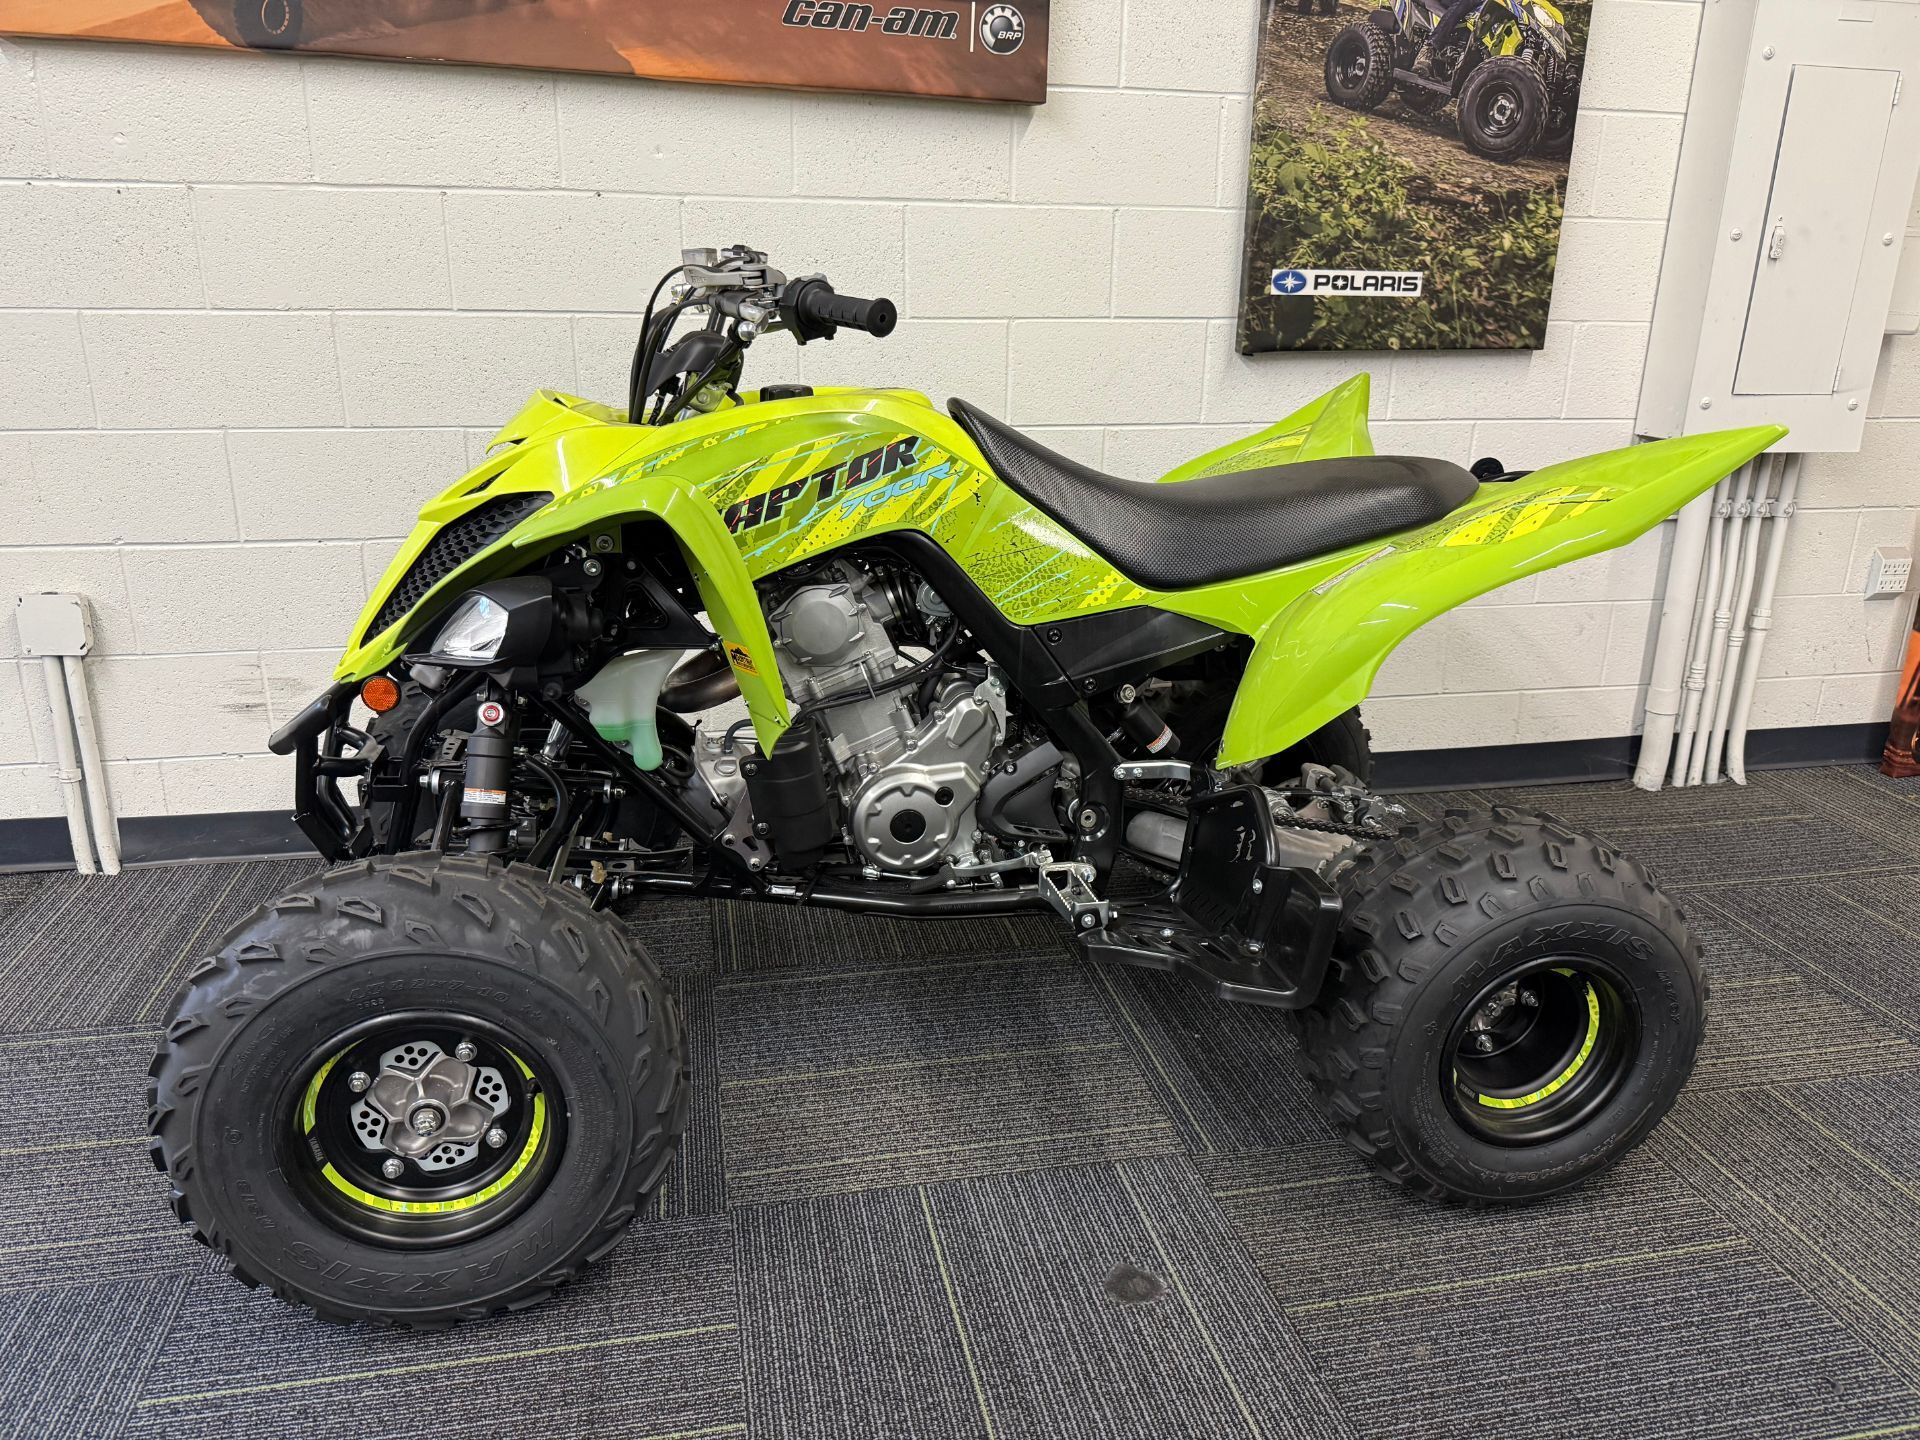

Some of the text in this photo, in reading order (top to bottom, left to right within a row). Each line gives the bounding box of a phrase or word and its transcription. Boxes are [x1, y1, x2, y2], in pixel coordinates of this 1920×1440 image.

[782, 0, 959, 39] can-am
[998, 31, 1021, 40] BRP
[1314, 275, 1419, 292] POLARIS
[717, 435, 922, 535] APTOR
[840, 461, 955, 520] 700R
[1448, 921, 1657, 1007] MAXXIS
[282, 1217, 553, 1293] MAXXIS
